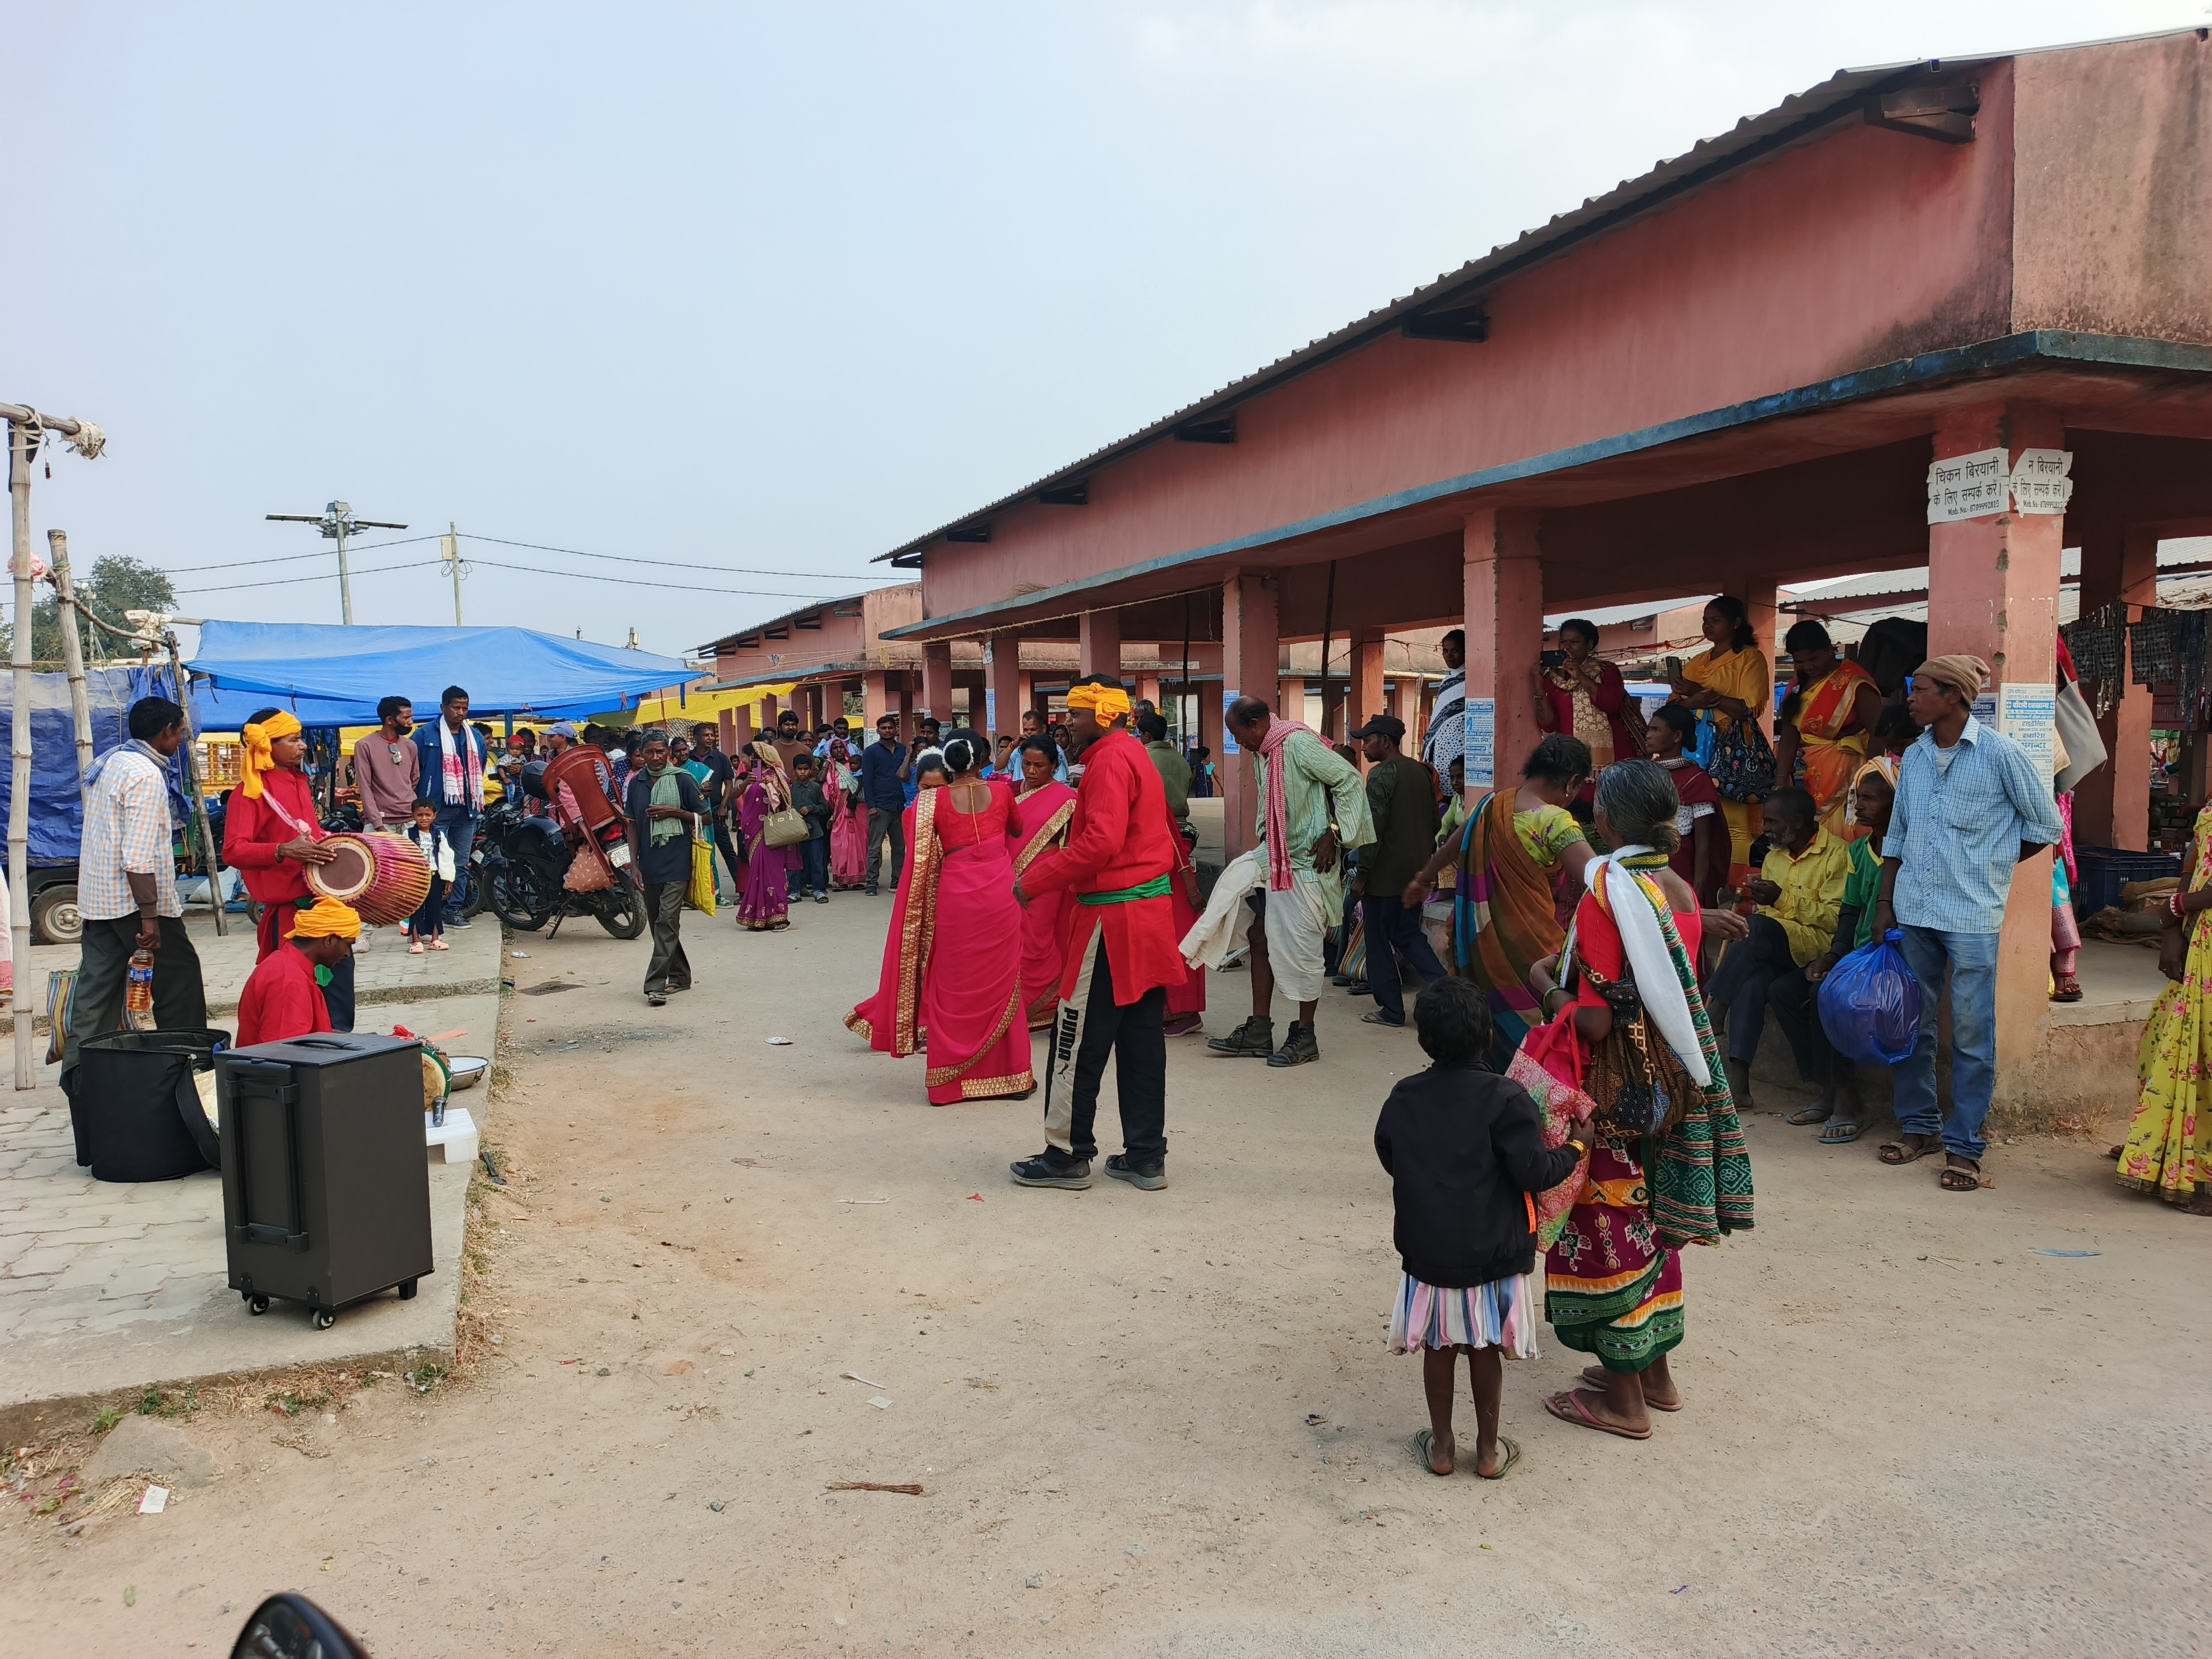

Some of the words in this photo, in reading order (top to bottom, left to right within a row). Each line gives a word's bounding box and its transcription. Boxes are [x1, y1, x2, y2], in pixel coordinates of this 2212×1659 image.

[1936, 468, 1961, 485] चिकन
[1965, 457, 1999, 479] बिरयानी
[2038, 456, 2064, 475] बिरयानी
[1933, 490, 1941, 507] के
[1944, 488, 1958, 506] लिए
[1961, 481, 1982, 502] सम्पर्क
[2012, 476, 2018, 495] के
[2020, 478, 2031, 498] लिए
[2034, 479, 2050, 497] सम्पर्क
[1058, 1007, 1079, 1061] PUMA
